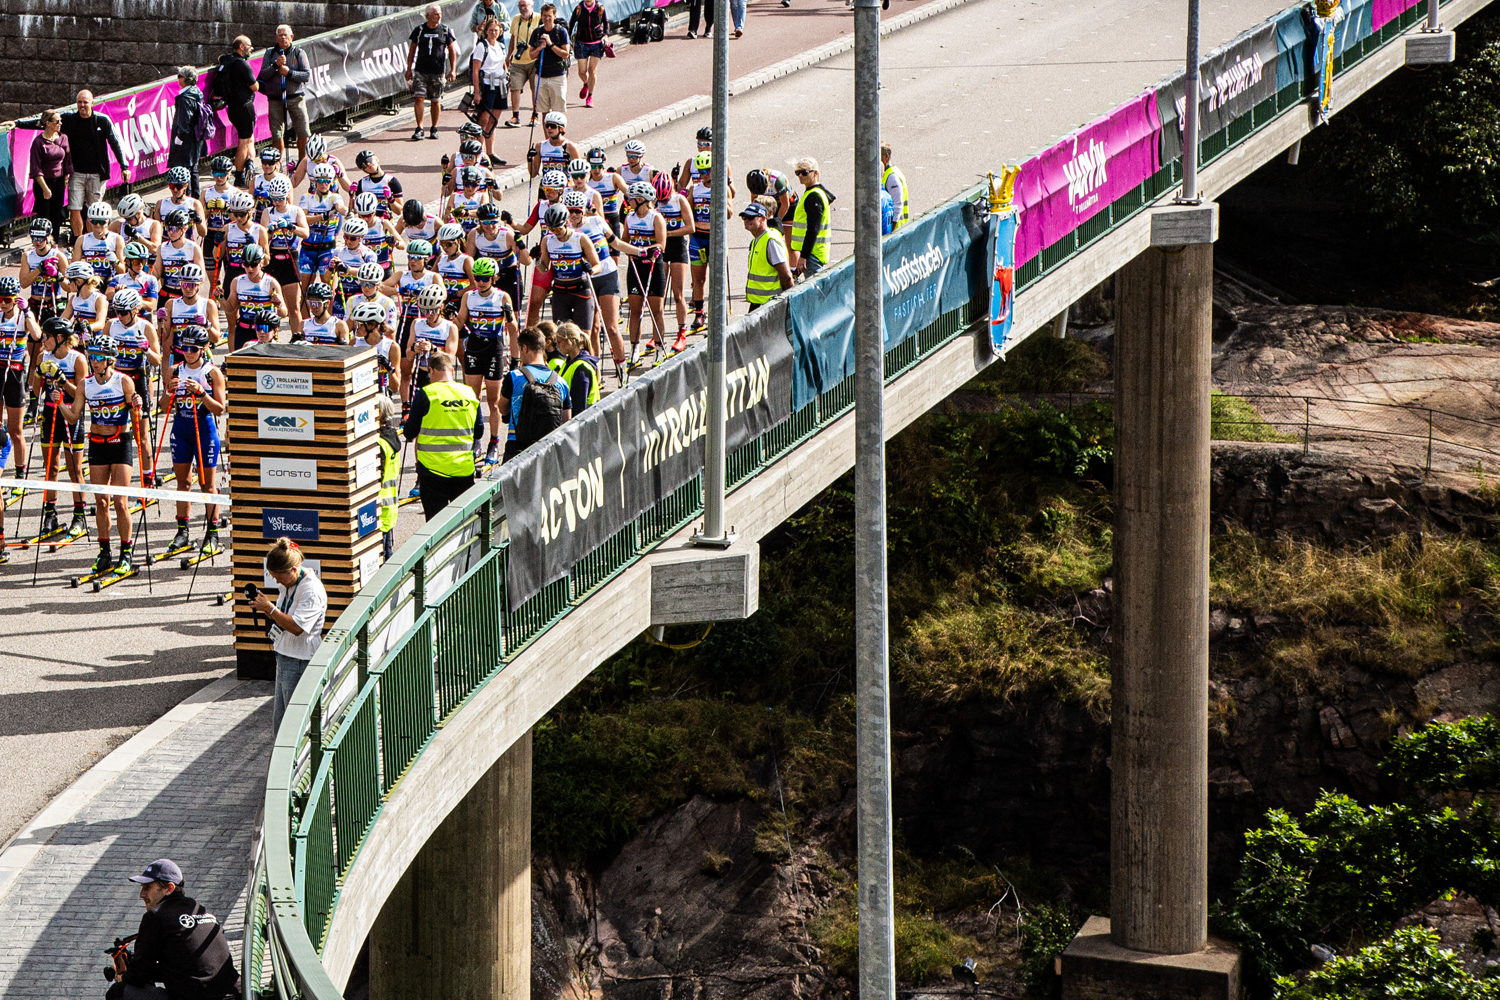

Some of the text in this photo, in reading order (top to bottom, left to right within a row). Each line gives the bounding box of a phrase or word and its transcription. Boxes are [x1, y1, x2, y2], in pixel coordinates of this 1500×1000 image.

[140, 152, 169, 169] TROLLHÄTT
[696, 204, 709, 215] 55
[552, 259, 576, 271] 531
[883, 242, 944, 297] Kraftstaden
[165, 267, 179, 278] 52
[444, 280, 459, 291] 32
[471, 317, 496, 331] 521
[115, 347, 138, 360] 13
[92, 405, 121, 419] 502
[640, 354, 770, 474] inTROLLTTAN
[263, 415, 296, 427] GKN
[267, 516, 285, 524] VAST
[272, 523, 314, 532] SVERIGE.com
